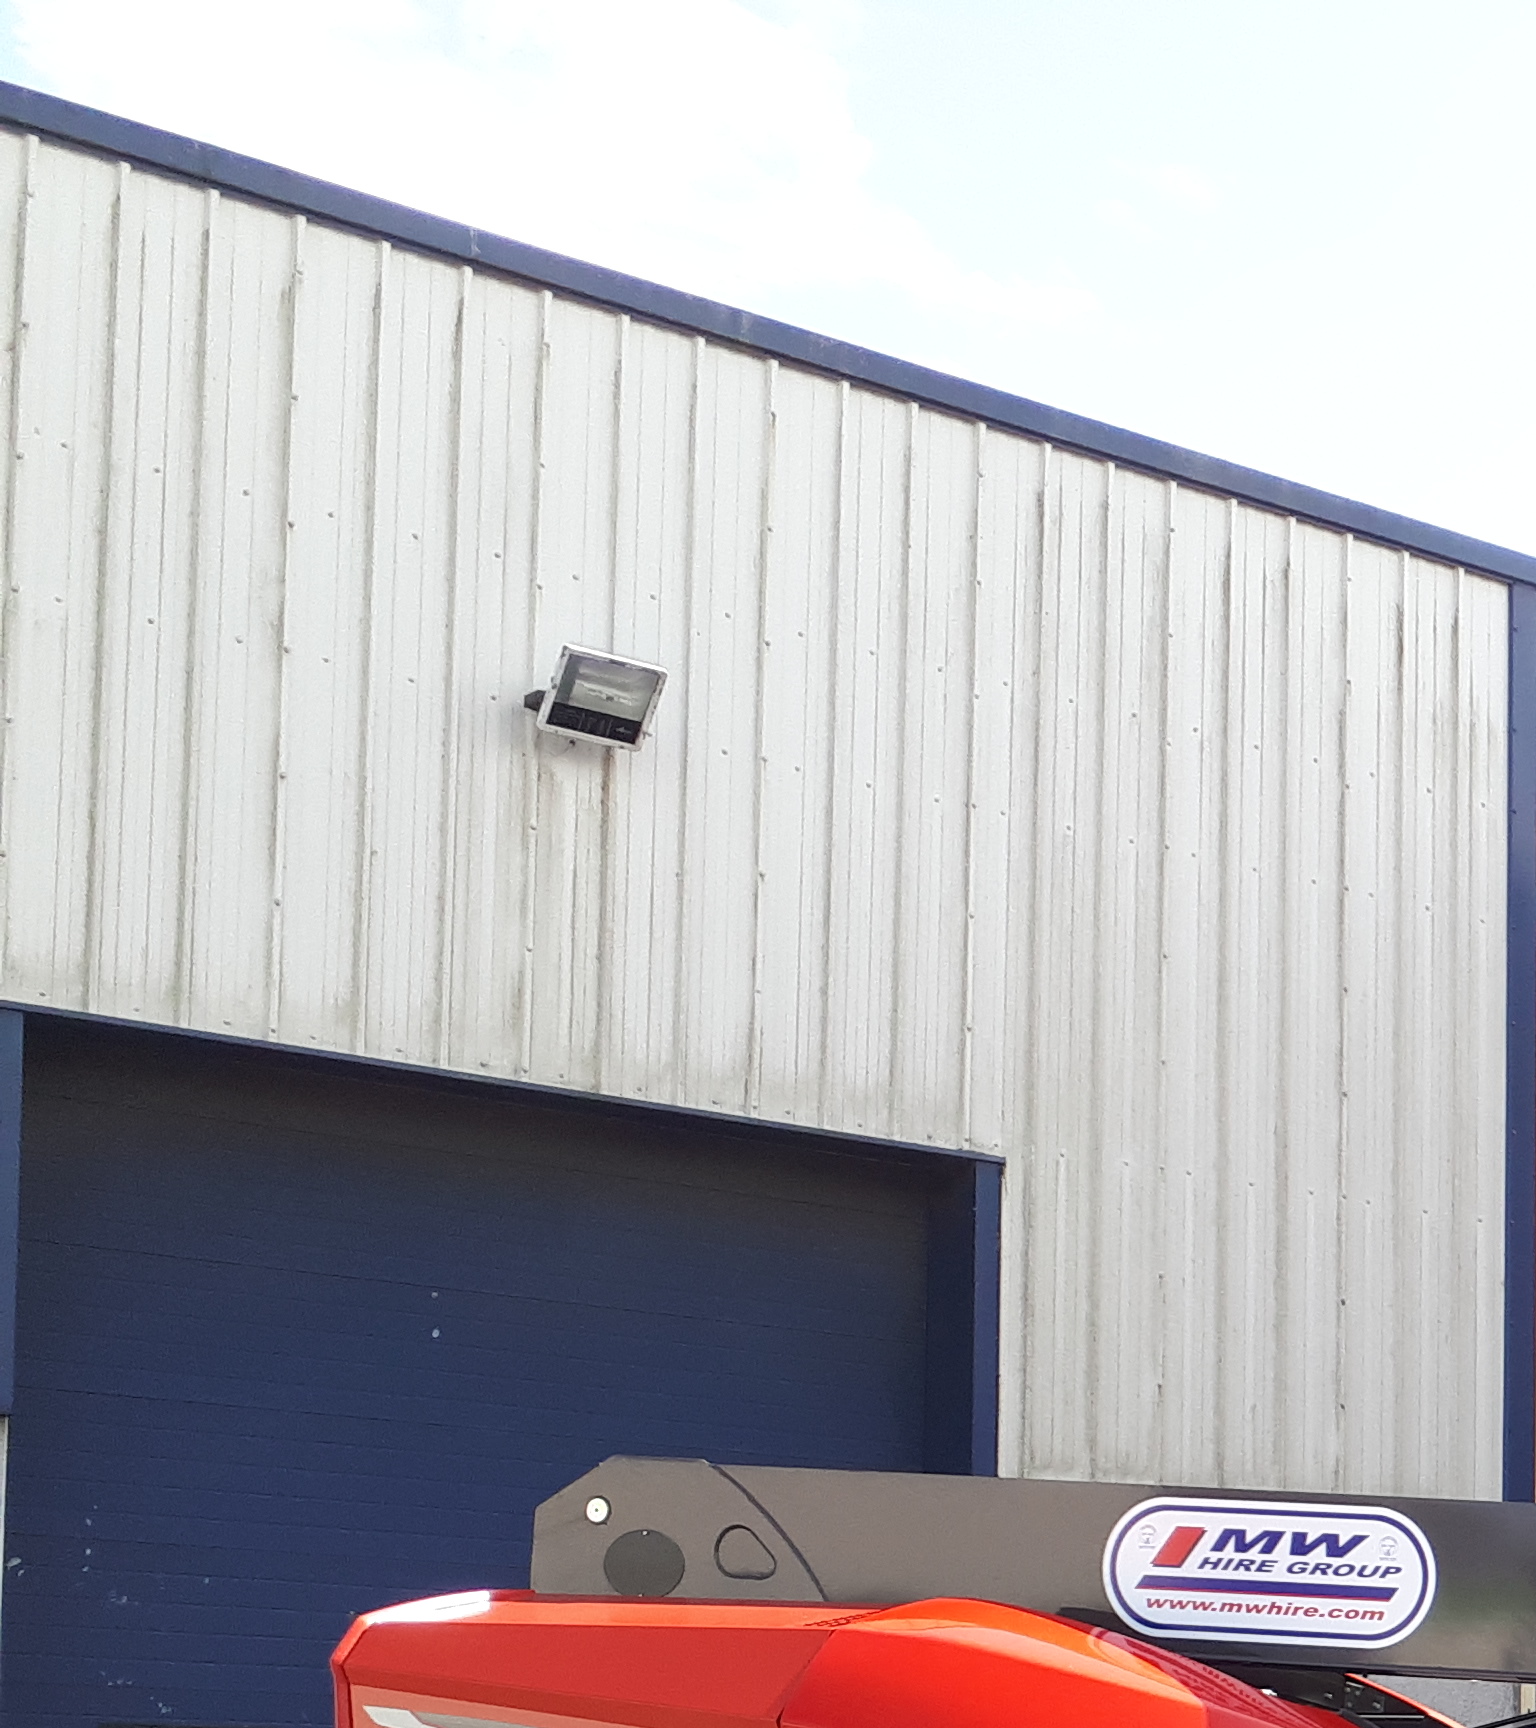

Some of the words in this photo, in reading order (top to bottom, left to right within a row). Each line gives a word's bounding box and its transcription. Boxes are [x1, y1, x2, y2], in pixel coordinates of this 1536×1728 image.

[1209, 1528, 1371, 1559] MW
[1196, 1556, 1278, 1574] HIRE
[1286, 1561, 1403, 1579] GROUP
[1145, 1597, 1386, 1622] www.mwhire.com
